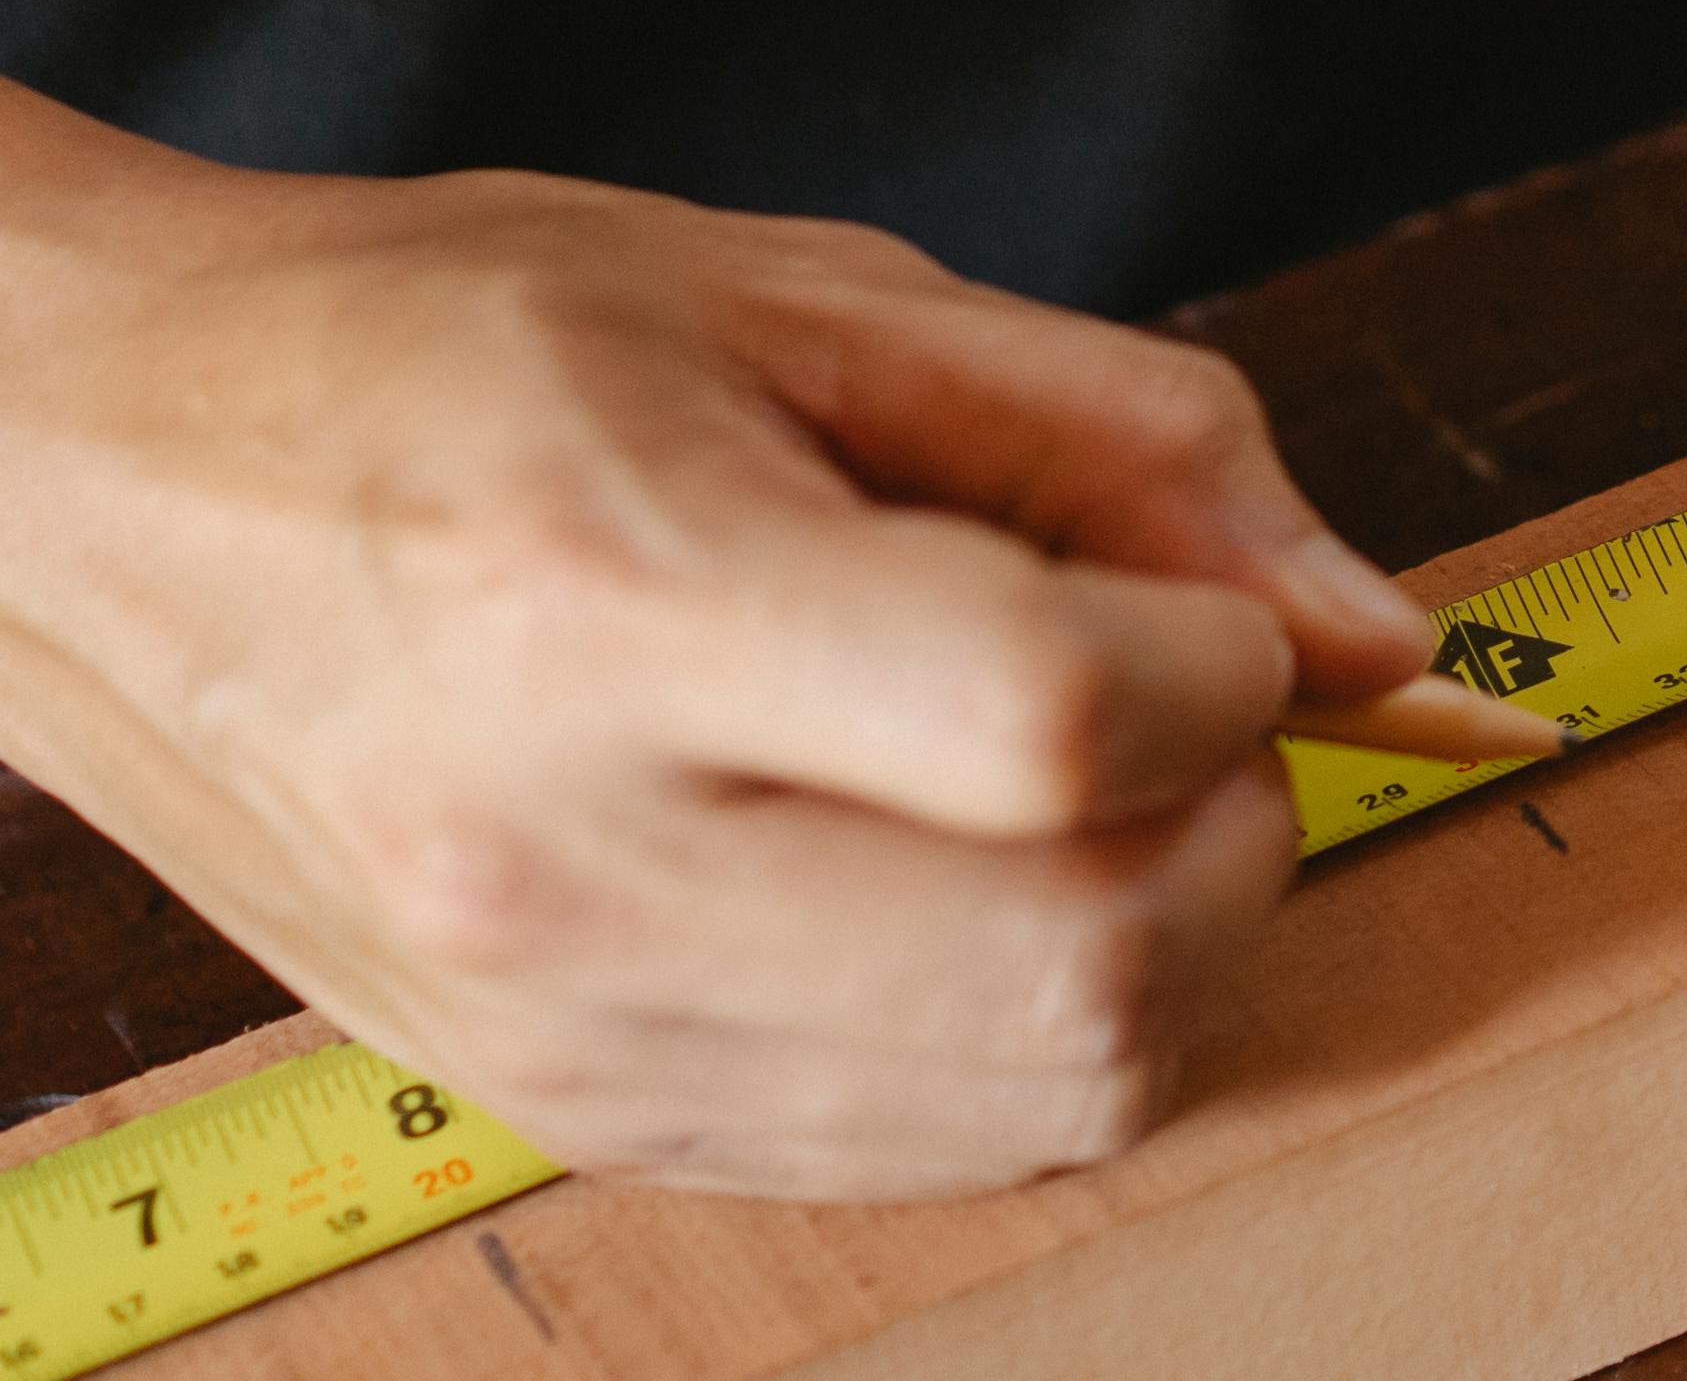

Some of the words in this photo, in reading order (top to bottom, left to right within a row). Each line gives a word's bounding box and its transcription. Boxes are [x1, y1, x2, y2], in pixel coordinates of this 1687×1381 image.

[1452, 638, 1523, 694] 1F
[1556, 705, 1600, 729] 31
[1356, 783, 1409, 811] 29
[388, 1084, 450, 1140] 8
[413, 1157, 473, 1199] 20
[110, 1188, 161, 1248] 7
[325, 1206, 368, 1235] 19
[216, 1251, 258, 1279] 18
[107, 1293, 146, 1325] 17
